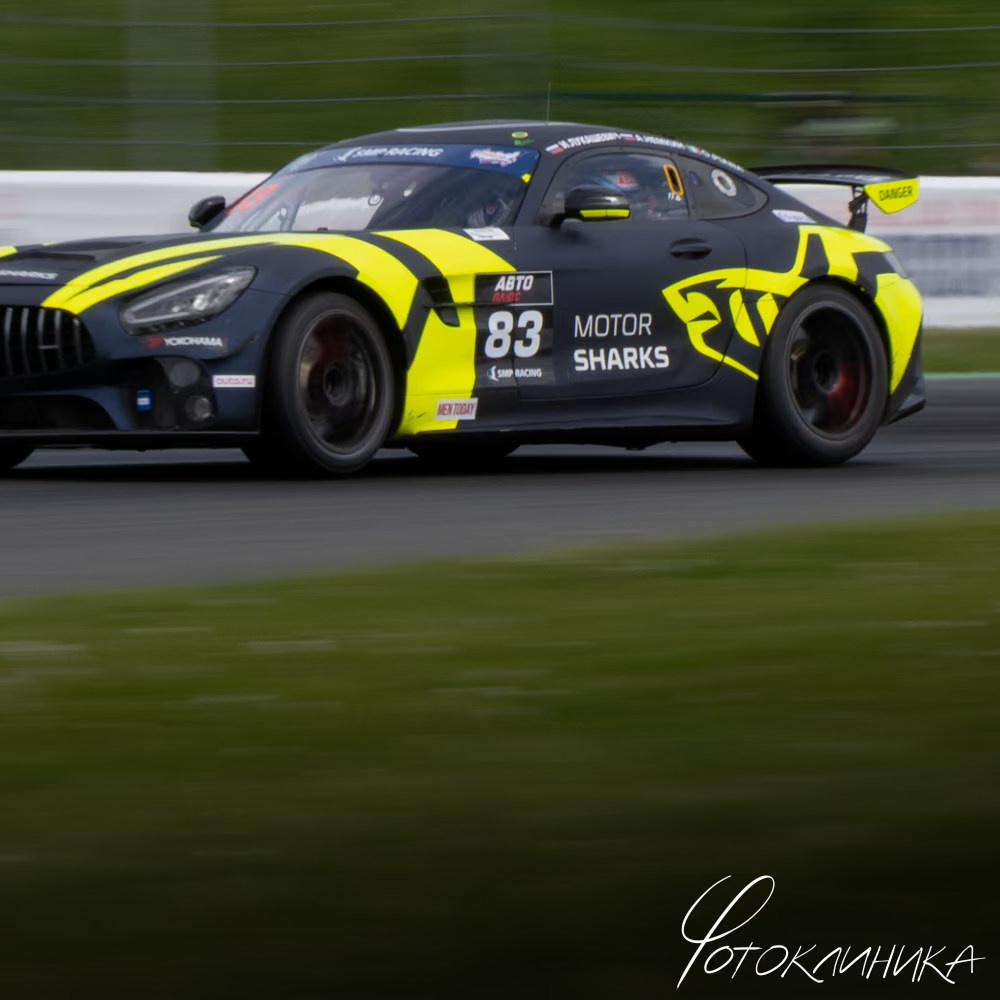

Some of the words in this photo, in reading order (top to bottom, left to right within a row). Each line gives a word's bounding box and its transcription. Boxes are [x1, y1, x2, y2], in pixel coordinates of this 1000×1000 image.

[384, 148, 444, 158] RACING
[878, 185, 913, 201] DANGER
[574, 313, 652, 338] MOTOR
[163, 336, 223, 347] YOKOHAMA
[484, 310, 544, 359] 83
[573, 345, 670, 372] SHARKS
[497, 369, 514, 378] SMP
[515, 368, 542, 378] RACING
[436, 403, 453, 416] MEN
[453, 403, 476, 416] TODAY
